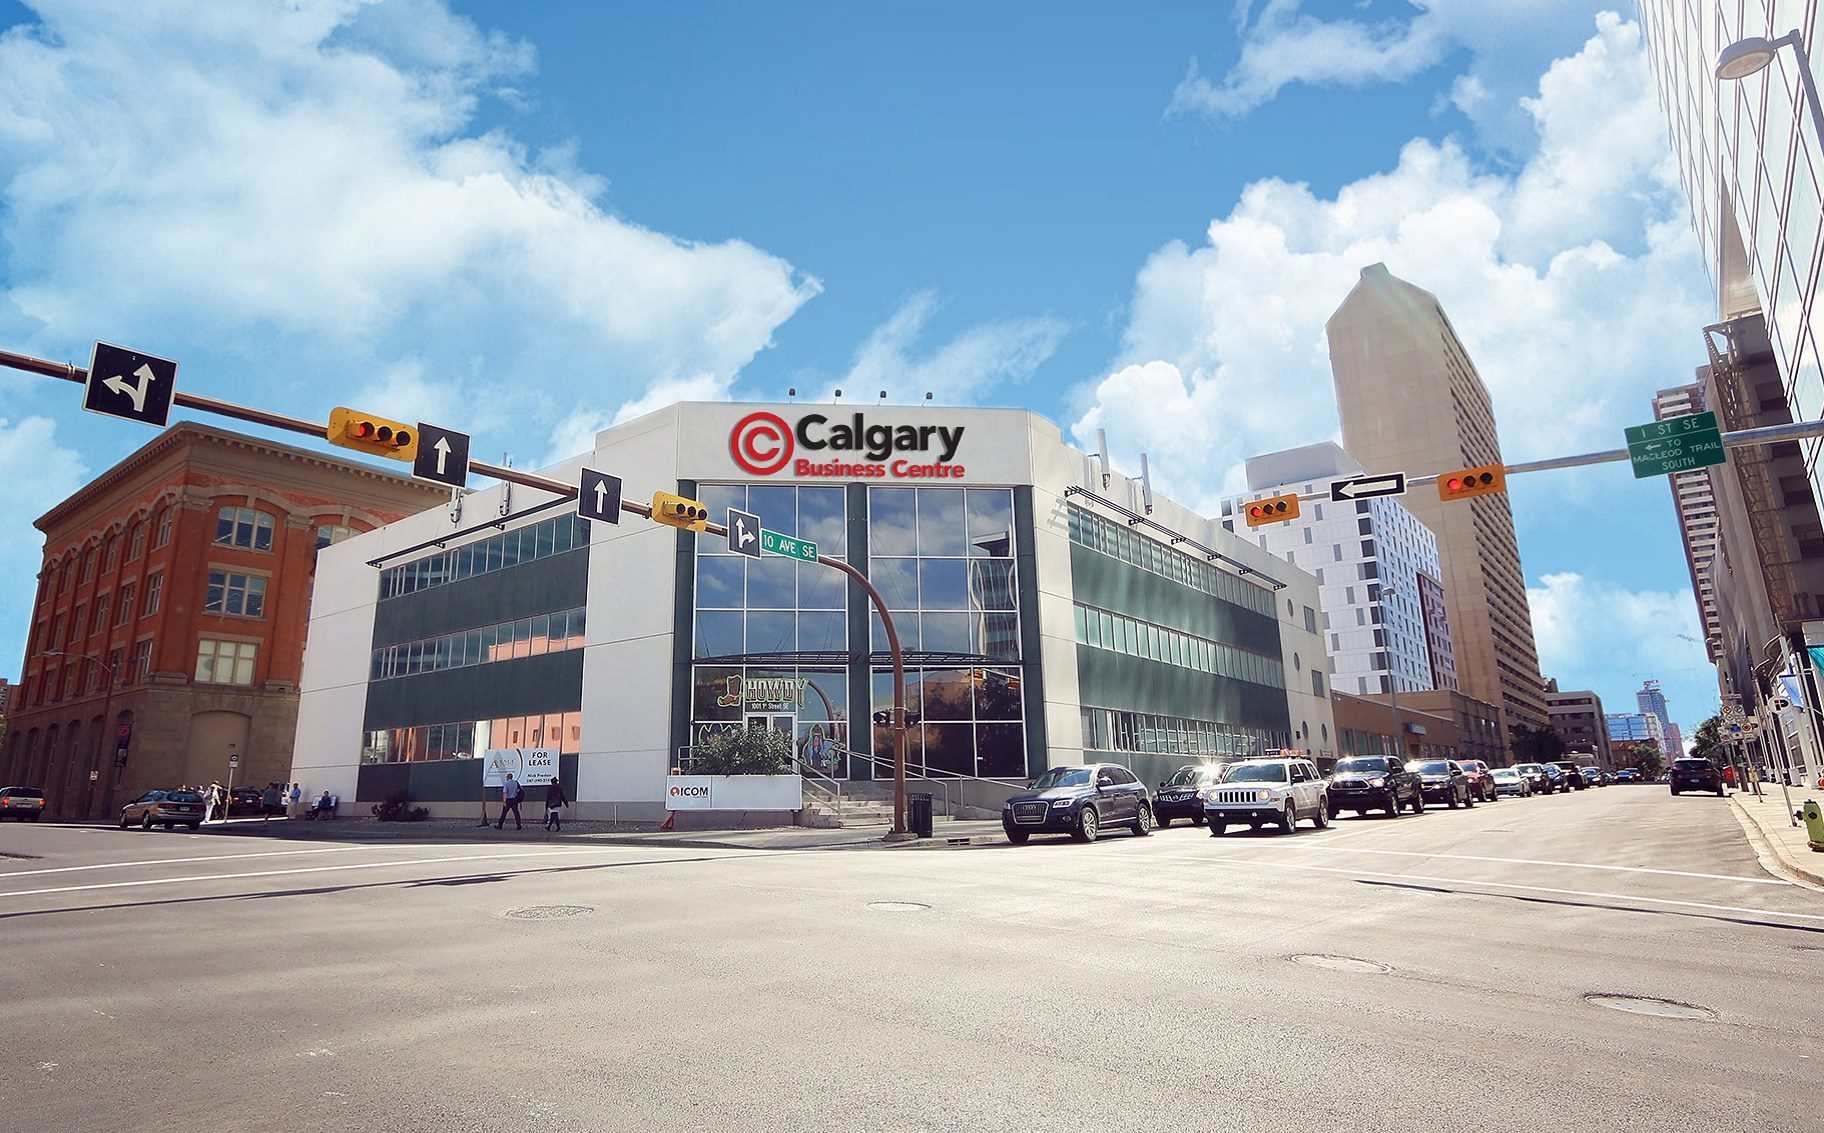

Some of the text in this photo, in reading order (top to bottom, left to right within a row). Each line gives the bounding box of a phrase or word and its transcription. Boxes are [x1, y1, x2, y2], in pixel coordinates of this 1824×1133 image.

[1657, 423, 1672, 435] ST
[1683, 418, 1700, 430] SE
[797, 413, 965, 461] Calgary
[1666, 438, 1682, 447] TO
[1633, 441, 1721, 464] MACLEOD TRAIL
[796, 459, 965, 478] Business Centre
[1662, 456, 1696, 471] SOUTH
[763, 534, 815, 558] 10 AVE SE
[746, 678, 808, 709] HOWDY
[680, 787, 708, 796] ICOM
